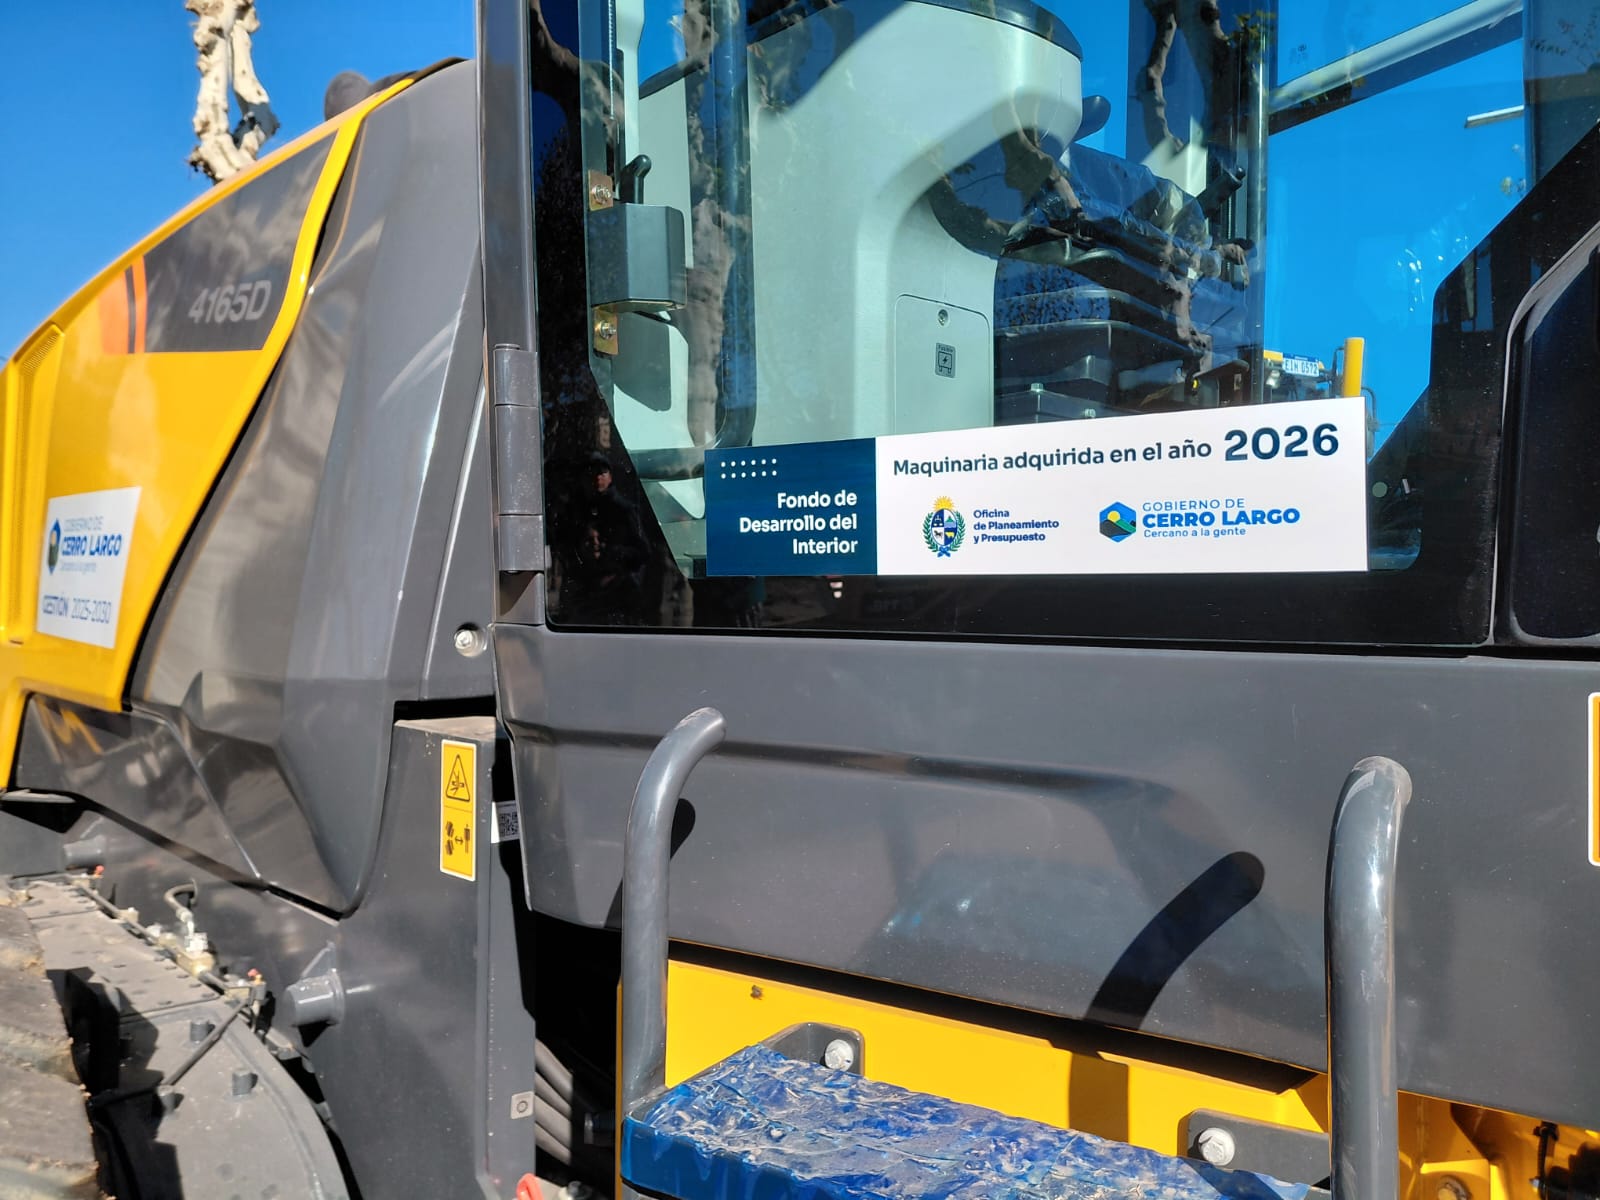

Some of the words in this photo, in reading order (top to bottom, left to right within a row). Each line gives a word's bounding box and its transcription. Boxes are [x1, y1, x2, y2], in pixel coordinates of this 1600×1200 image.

[188, 280, 272, 324] 4165D
[893, 454, 998, 477] Maquinaria
[1003, 447, 1104, 471] adquirida
[1110, 443, 1137, 463] en
[1142, 442, 1163, 461] el
[1168, 439, 1212, 460] año
[1224, 423, 1339, 462] 2026
[777, 491, 831, 509] Fondo
[834, 489, 858, 507] de
[1142, 498, 1220, 512] GOBIERNO
[1225, 498, 1245, 509] DE
[739, 514, 827, 533] Desarrollo
[829, 513, 857, 531] del
[973, 508, 1010, 519] Oficina
[1142, 511, 1216, 529] CERRO
[1222, 507, 1301, 526] LARGO
[973, 521, 987, 531] de
[988, 519, 1060, 530] Planeamiento
[1143, 528, 1189, 539] Cercano
[1191, 530, 1198, 538] a
[1200, 527, 1211, 537] la
[1213, 527, 1246, 539] gente
[62, 535, 88, 556] CERRO
[89, 533, 122, 556] LARGO
[792, 537, 858, 555] Interior
[973, 535, 980, 545] y
[981, 532, 1046, 544] Presupuesto
